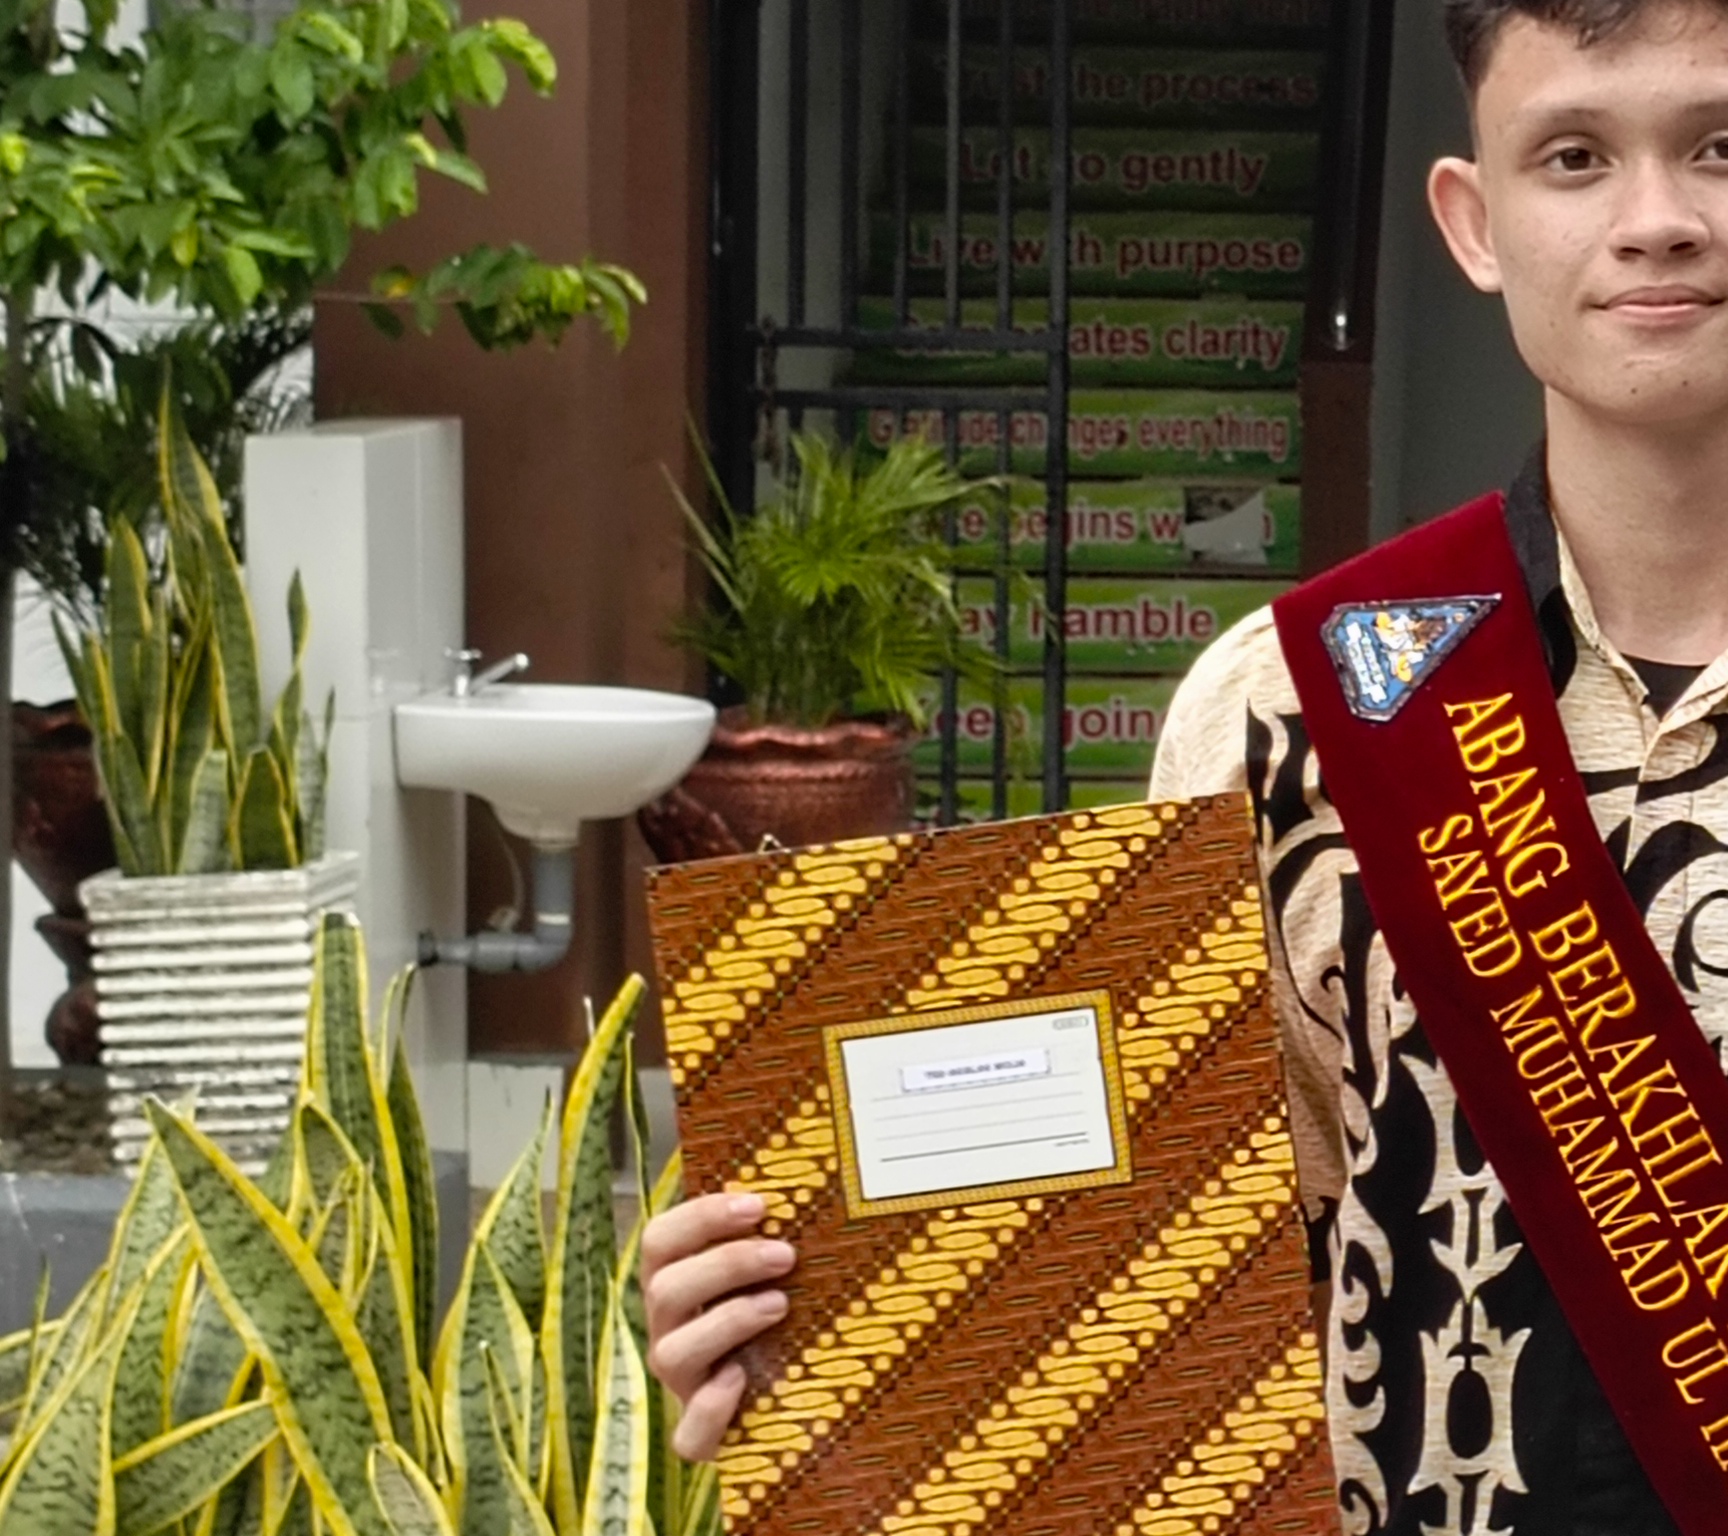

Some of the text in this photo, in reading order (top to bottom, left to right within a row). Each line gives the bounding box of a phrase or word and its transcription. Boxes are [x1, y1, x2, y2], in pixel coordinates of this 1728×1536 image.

[1064, 65, 1126, 98] he
[1142, 72, 1318, 106] process
[1120, 146, 1265, 194] gently
[1009, 231, 1103, 266] wh
[1117, 237, 1300, 277] purpose
[1164, 319, 1286, 368] clarity
[1007, 409, 1128, 456] chnges
[1138, 408, 1287, 460] everything
[1060, 697, 1163, 747] oin
[1442, 691, 1571, 899] ABANG
[1416, 812, 1525, 979] SAYED
[1488, 983, 1691, 1312] MUHAMMAD
